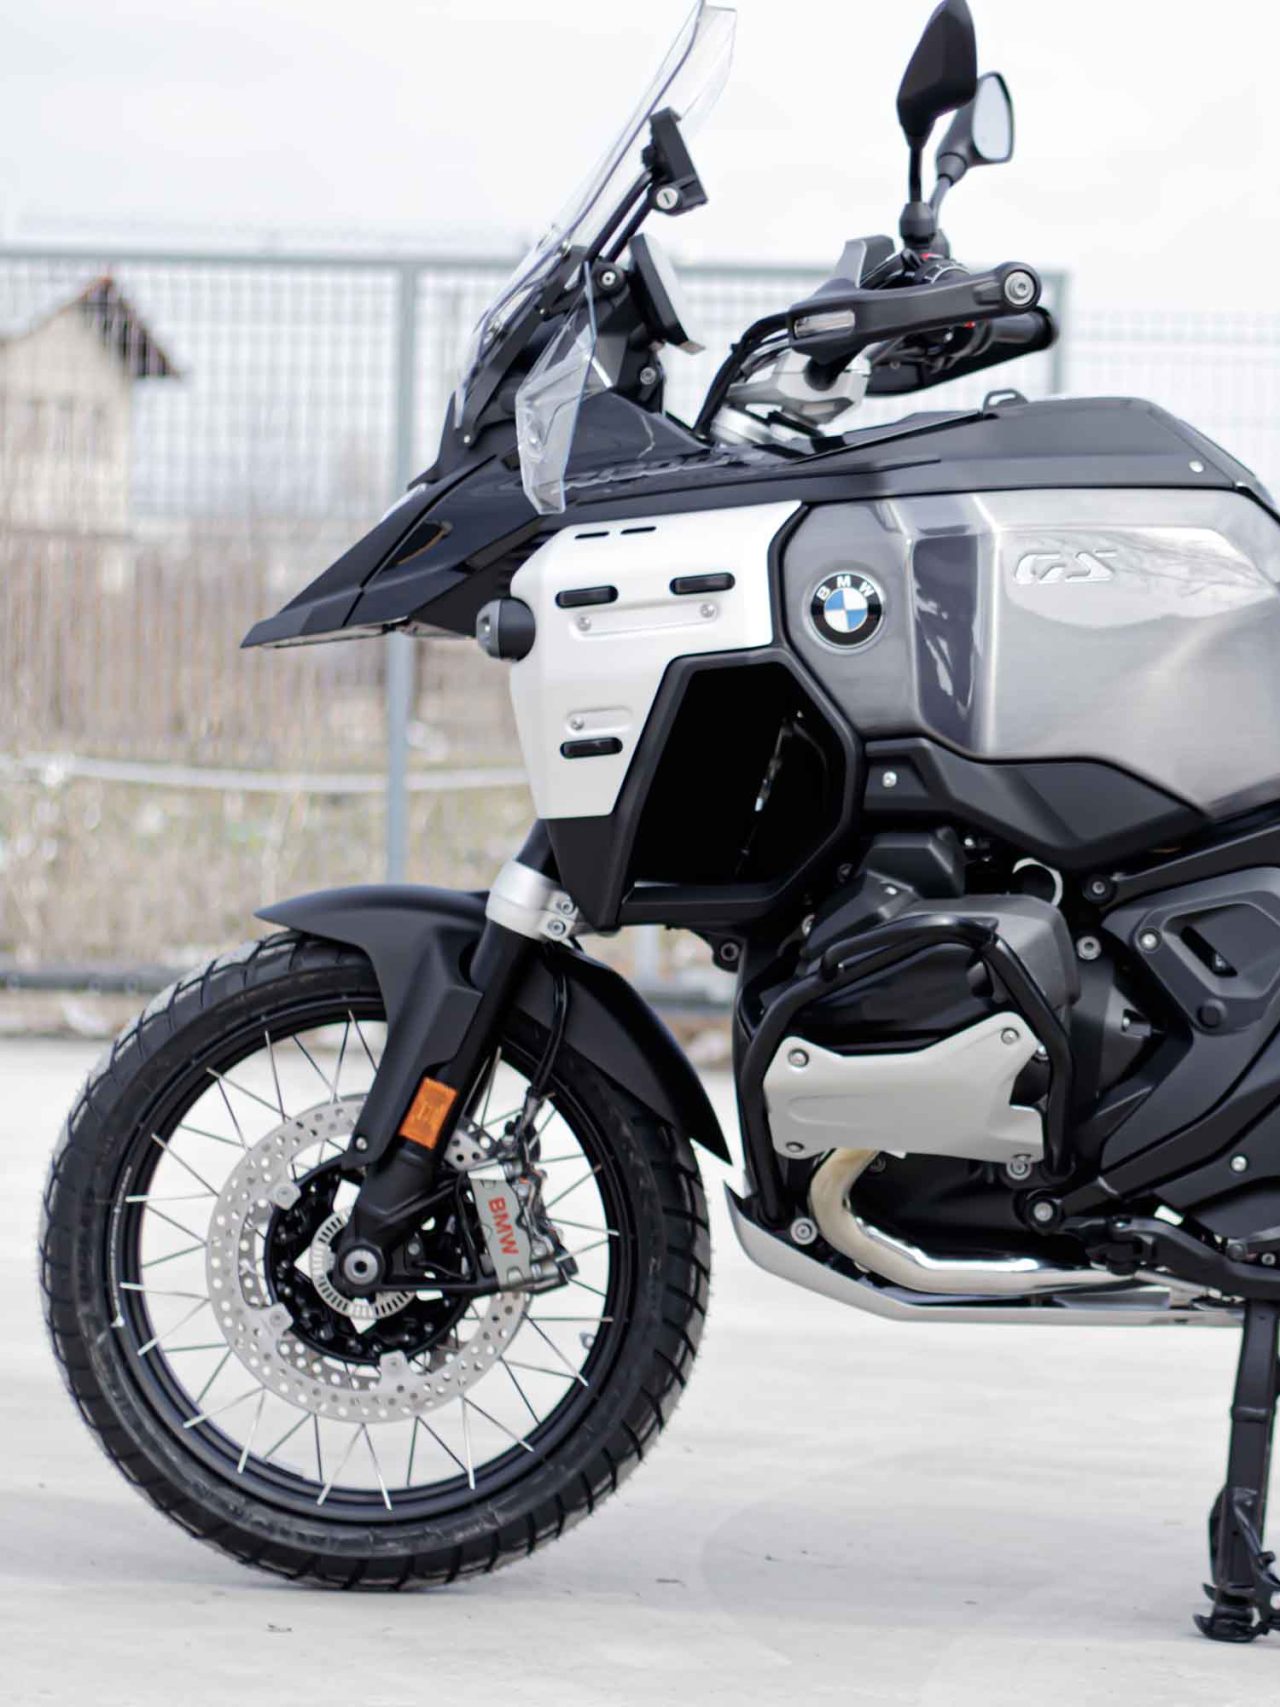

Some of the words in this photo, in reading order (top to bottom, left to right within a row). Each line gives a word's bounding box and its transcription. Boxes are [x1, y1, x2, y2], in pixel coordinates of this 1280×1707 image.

[1013, 549, 1118, 584] GS
[815, 575, 876, 601] BMW
[488, 1196, 520, 1255] BMW
